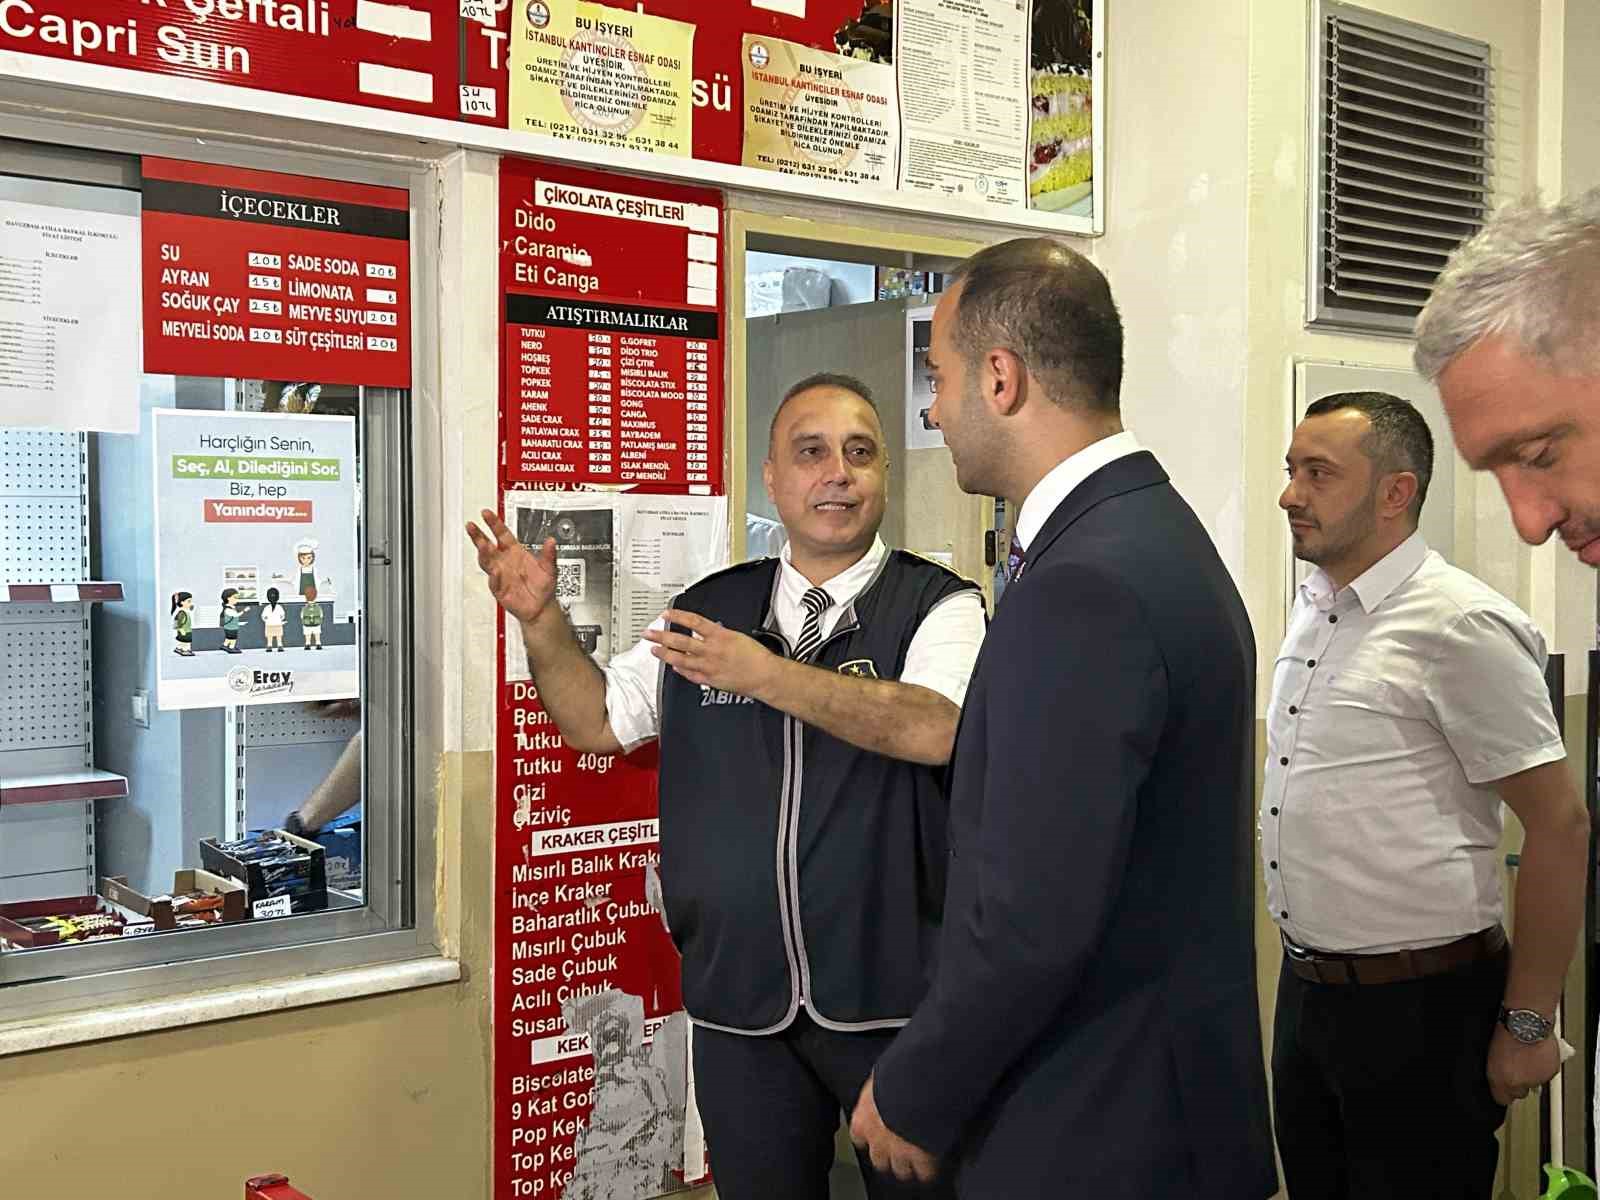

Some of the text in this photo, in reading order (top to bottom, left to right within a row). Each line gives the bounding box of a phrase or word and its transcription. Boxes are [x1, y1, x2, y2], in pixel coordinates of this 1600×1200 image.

[0, 2, 137, 56] Capri
[576, 17, 632, 38] BU İŞYERİ
[157, 25, 250, 74] Sun
[525, 26, 681, 70] İSTANBUL KANTİNCİLER ESNAF ODASI
[525, 63, 558, 76] ODAMIZ
[560, 70, 612, 86] TARAFINDAN
[536, 56, 671, 87] ÜRETİM VE HİJYEN KONTROLLERİ
[800, 64, 842, 80] BU İŞYERİ
[560, 88, 612, 104] BİLDİRMENİZ
[567, 81, 578, 89] VE
[641, 94, 677, 106] ODAMIZA
[752, 71, 789, 87] İSTANBUL
[841, 89, 864, 100] ESNAF
[866, 93, 888, 105] ODASI
[575, 101, 594, 110] RİCA
[759, 98, 787, 110] ÜRETİM
[789, 105, 799, 113] VE
[801, 107, 829, 118] HİJYEN
[780, 111, 828, 126] TARAFINDAN
[525, 118, 546, 128] TEL:
[550, 122, 580, 134] (0212)
[582, 127, 598, 136] 631
[668, 141, 679, 149] 44
[780, 129, 827, 144] BİLDİRMENİZ
[829, 137, 860, 150] ÖNEMLE
[786, 121, 794, 129] VE
[853, 134, 887, 145] ODAMIZA
[793, 140, 811, 149] RİCA
[220, 190, 340, 225] İÇECEKLER
[544, 186, 684, 221] ÇİKOLATA ÇEŞİTLERİ
[515, 209, 556, 232] Dido
[161, 244, 180, 262] SU
[288, 254, 360, 276] SADE SODA
[161, 269, 209, 287] AYRAN
[515, 262, 599, 293] Eti Canga
[288, 277, 354, 301] LİMONATA
[161, 290, 240, 316] SOĞUK ÇAY
[289, 304, 367, 325] MEYVE SUYU
[546, 305, 688, 331] ATIŞTIRMALIKLAR
[162, 320, 245, 341] MEYVELİ SODA
[286, 327, 364, 351] SÜT ÇEŞİTLERİ
[521, 328, 545, 338] TUTKU
[521, 365, 551, 375] TOPKEK
[521, 390, 549, 399] KARAM
[620, 399, 643, 408] GONG
[521, 402, 548, 411] AHENK
[620, 410, 647, 418] CANGA
[521, 415, 563, 425] SADE CRAX
[521, 427, 580, 437] PATLAYAN CRAX
[200, 435, 314, 453] Harçlığın Senin,
[562, 440, 583, 449] CRAX
[541, 452, 562, 460] CRAX
[177, 459, 339, 477] Seç, Al, Dilediğini Sor.
[521, 463, 575, 473] SUSAMLI CRAX
[230, 483, 287, 499] Biz, hep
[213, 503, 308, 520] Yanındayız...
[253, 671, 291, 686] Eray
[513, 733, 562, 751] Tutku
[513, 753, 615, 777] Tutku 40gr
[541, 829, 604, 849] KRAKER
[512, 860, 565, 883] Mısırlı
[571, 854, 614, 876] Balık
[555, 881, 612, 903] Kraker
[512, 907, 600, 934] Baharatlık
[512, 927, 626, 960] Mısırlı Çubuk
[512, 953, 618, 985] Sade Çubuk
[511, 989, 550, 1012] Acılı
[557, 1036, 589, 1054] KEK
[512, 1098, 558, 1120] 9 Kat
[512, 1115, 586, 1147] Pop Kek
[511, 1153, 544, 1172] Top
[511, 1178, 544, 1197] Top
